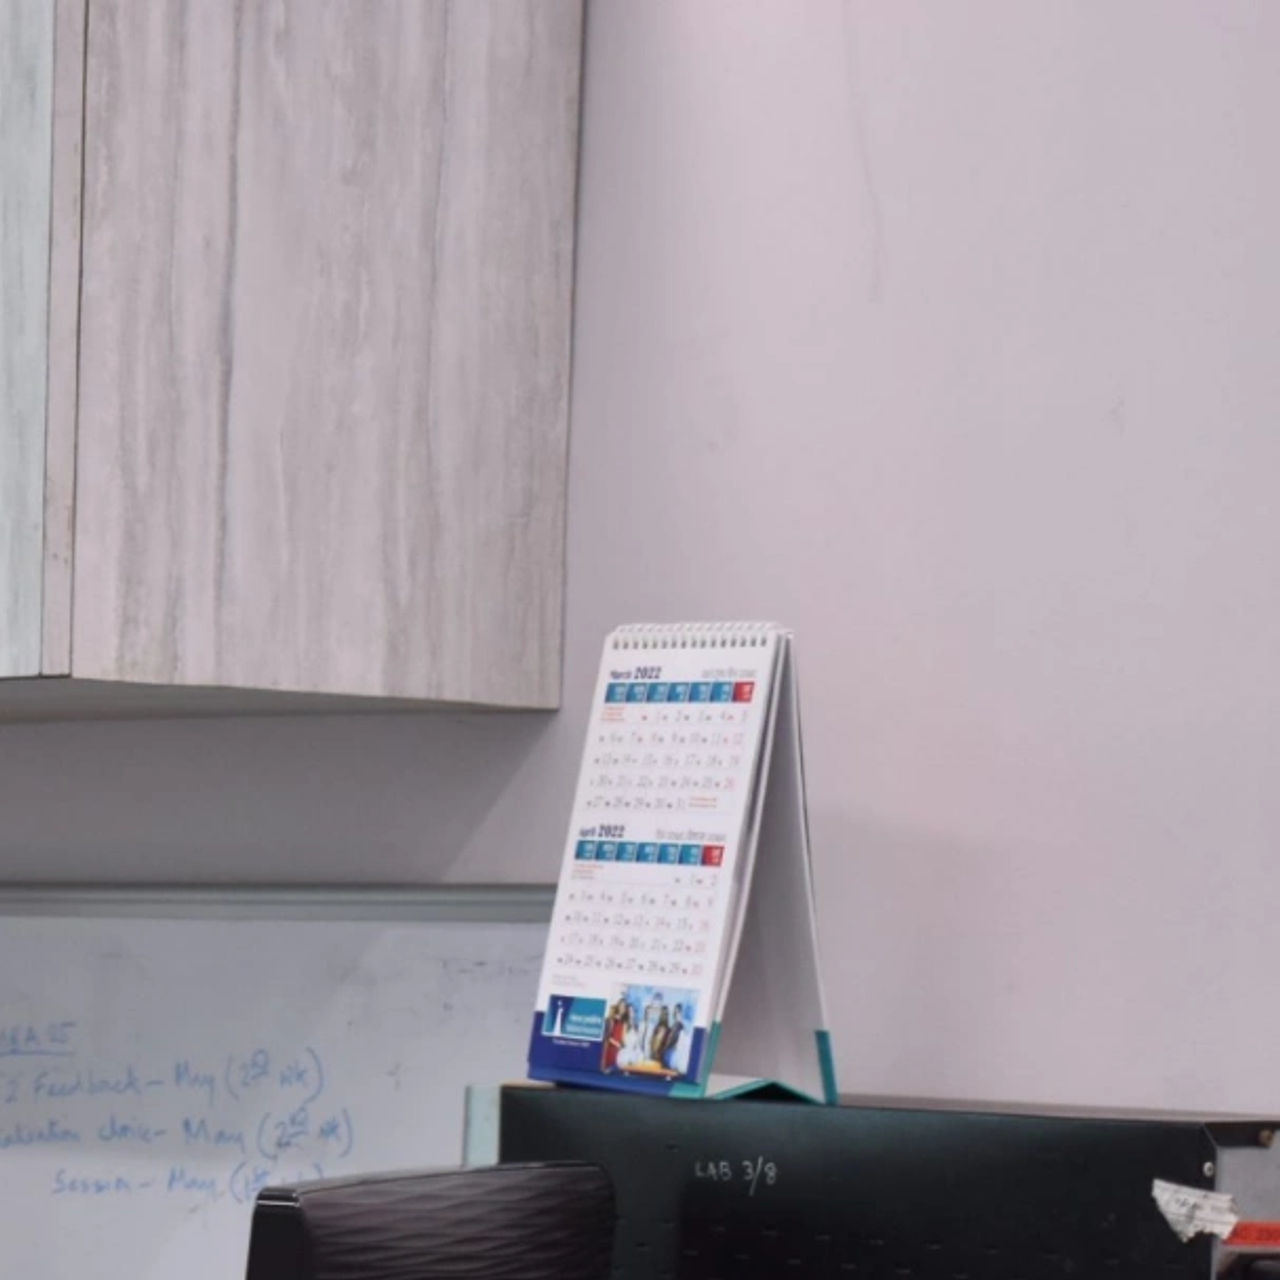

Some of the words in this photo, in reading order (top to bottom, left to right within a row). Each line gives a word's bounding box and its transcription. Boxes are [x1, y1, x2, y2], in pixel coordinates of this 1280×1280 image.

[633, 666, 662, 680] 2022
[597, 824, 626, 839] 2022
[694, 1160, 733, 1182] LAB
[741, 1155, 778, 1198] 3/8
